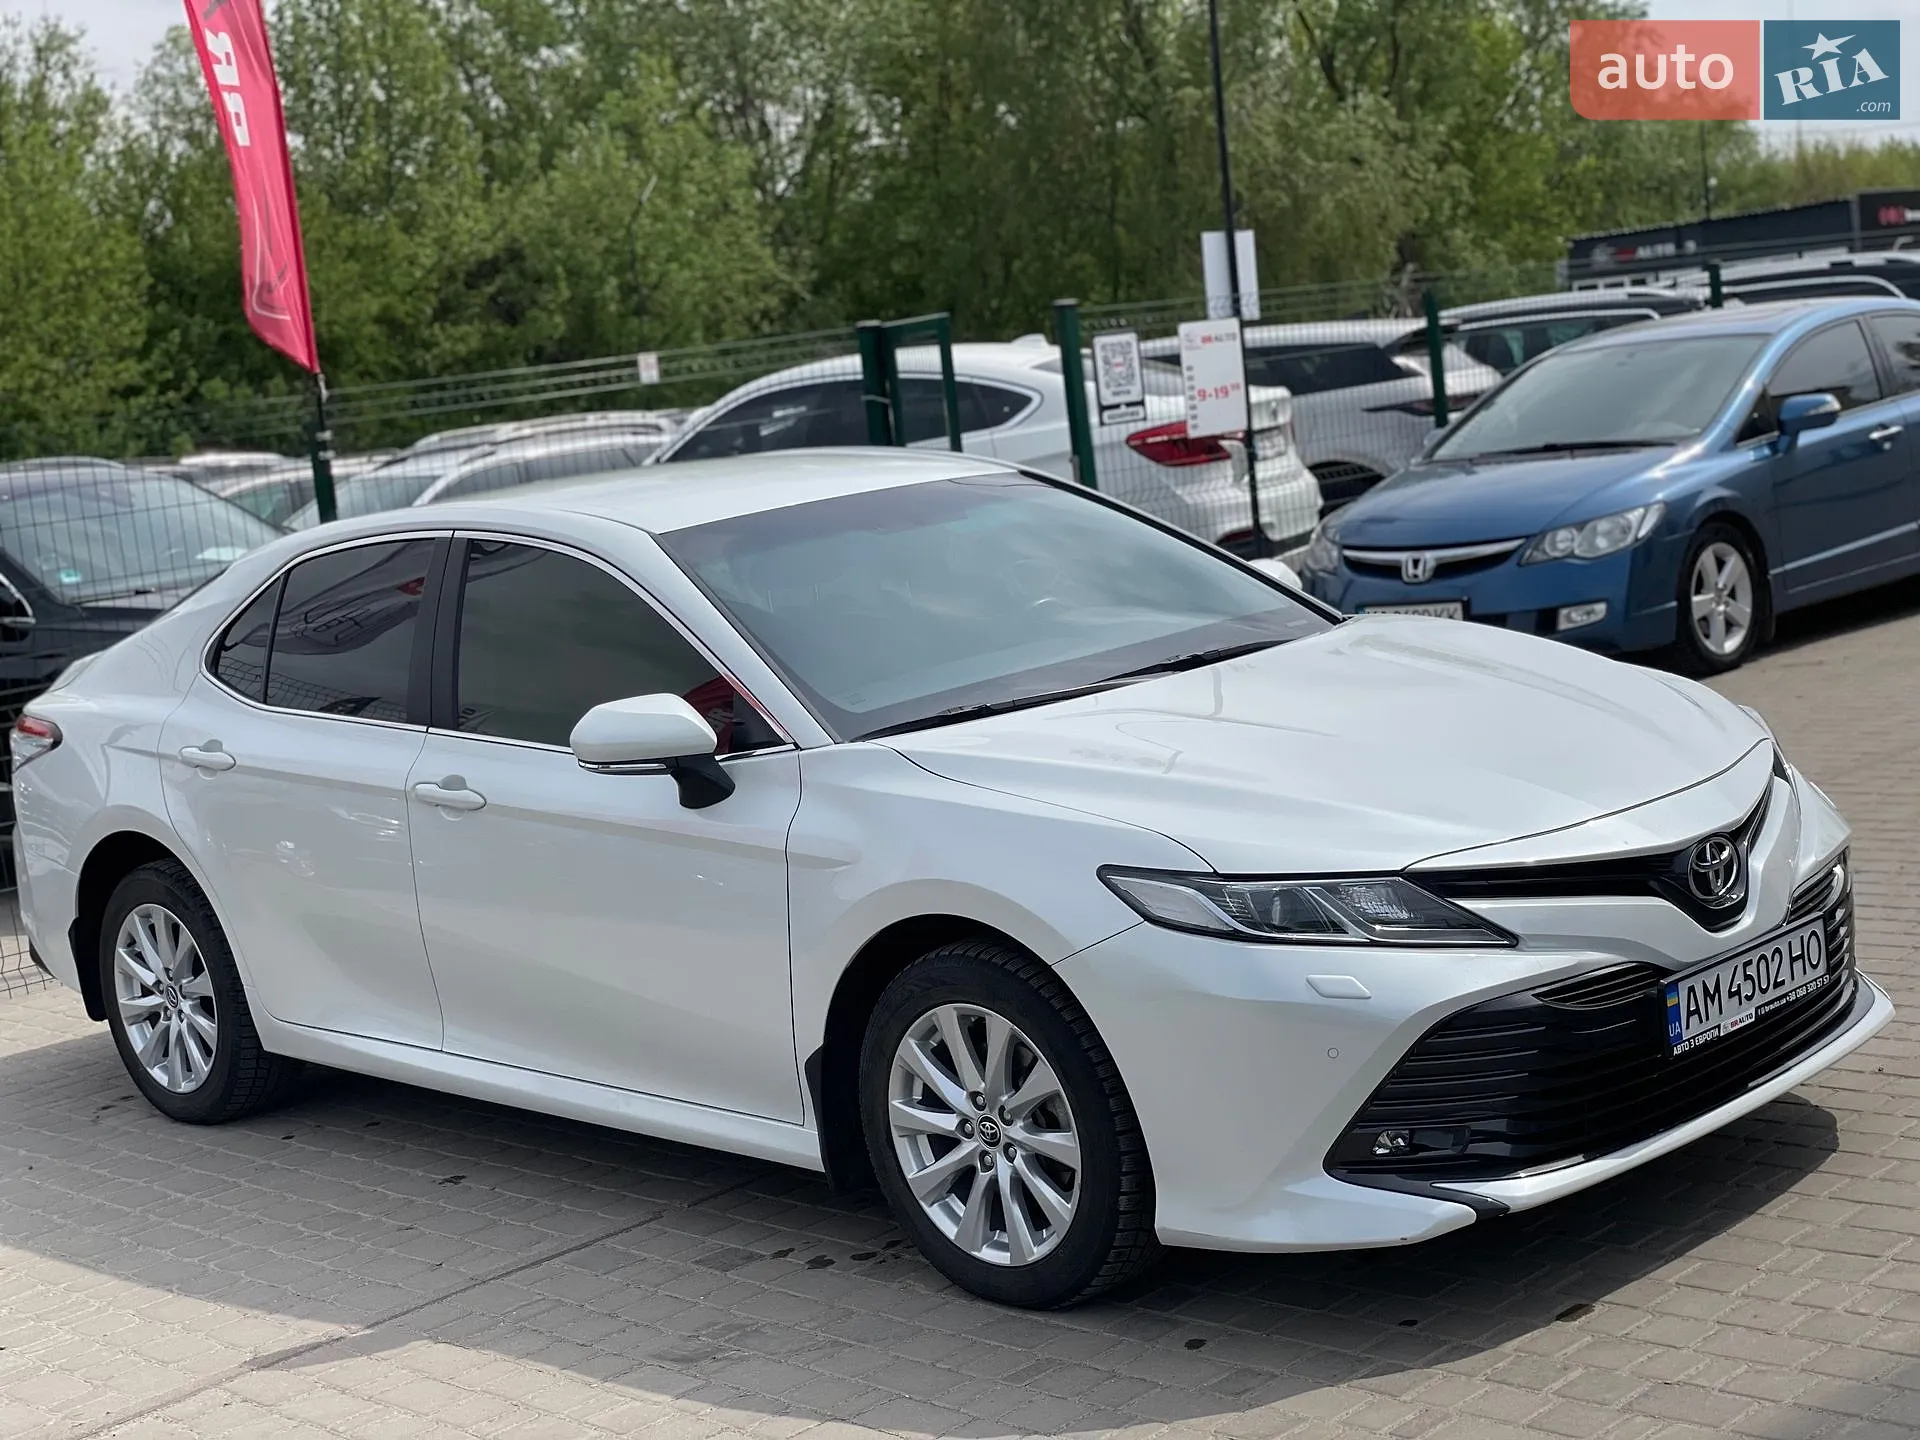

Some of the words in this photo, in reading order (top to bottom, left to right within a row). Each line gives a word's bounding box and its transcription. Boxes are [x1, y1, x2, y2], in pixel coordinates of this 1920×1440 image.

[1685, 973, 1723, 1030] AM
[1727, 946, 1786, 1006] 4502
[1788, 929, 1822, 981] HO
[1668, 1021, 1681, 1037] UA
